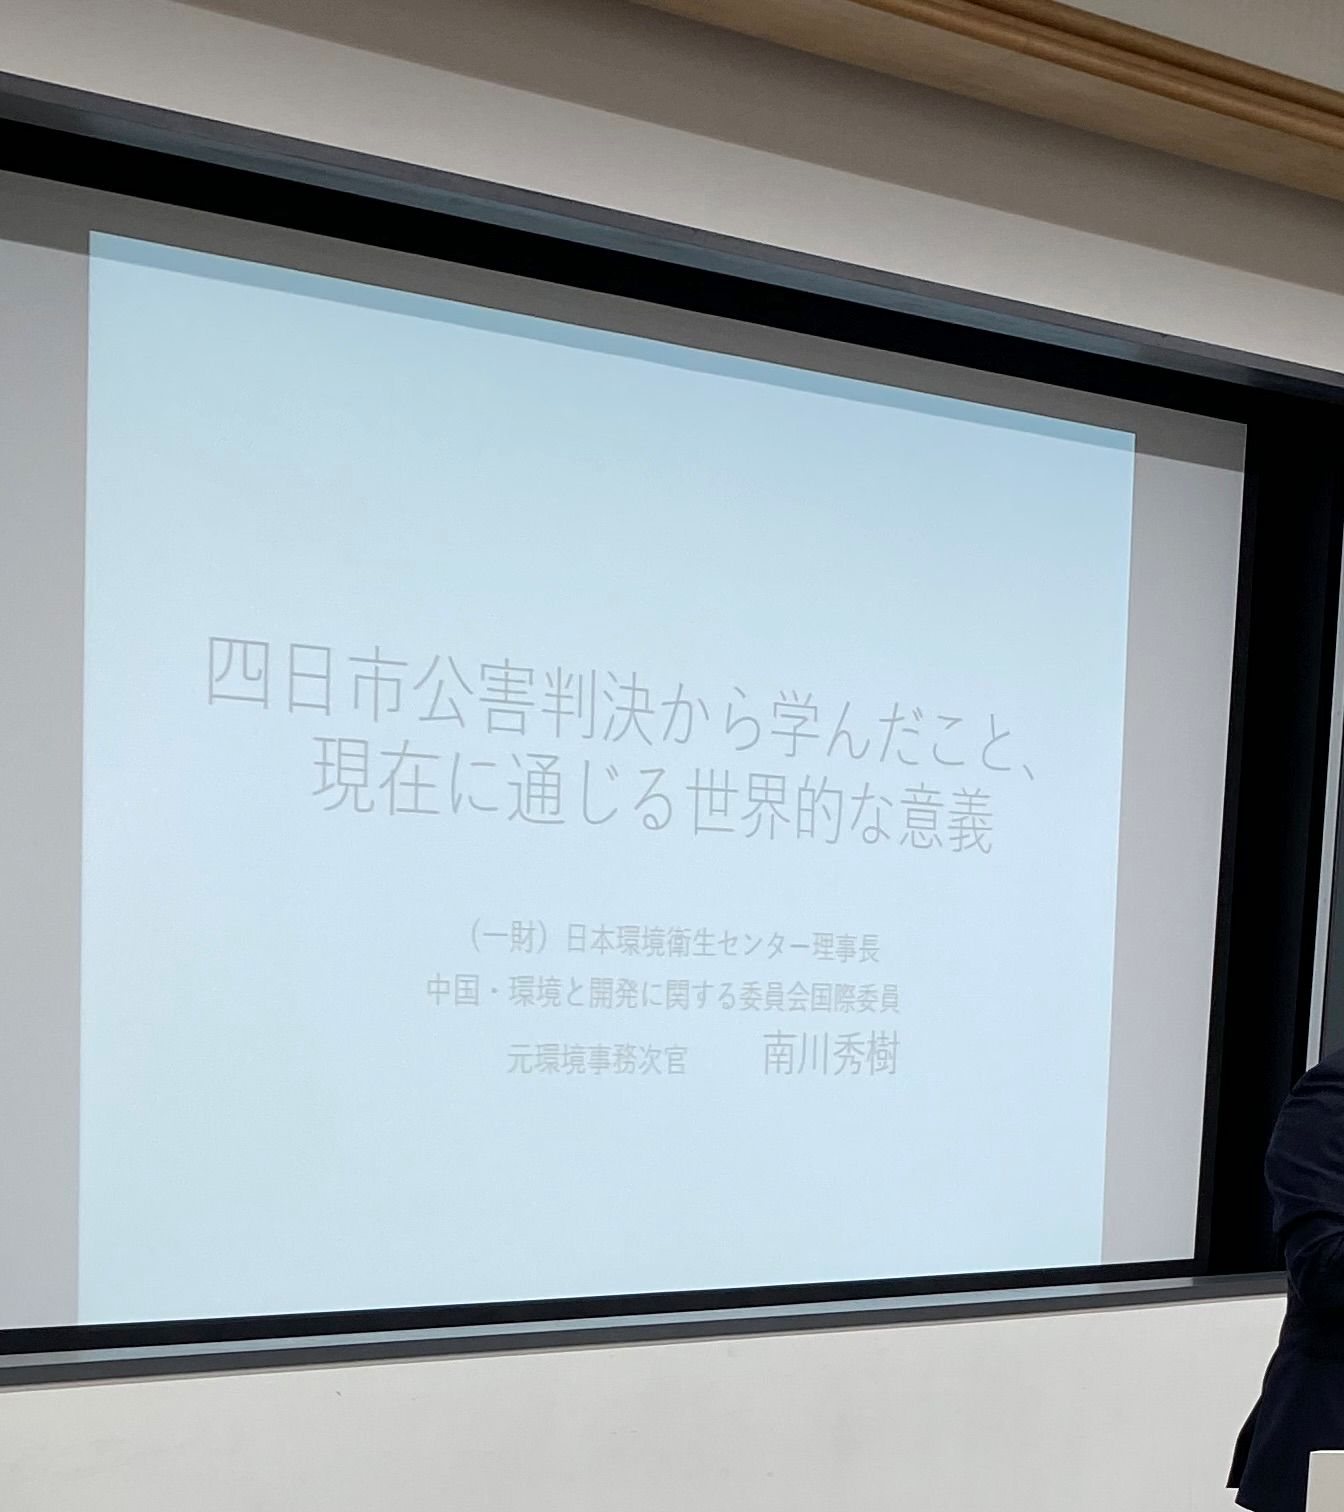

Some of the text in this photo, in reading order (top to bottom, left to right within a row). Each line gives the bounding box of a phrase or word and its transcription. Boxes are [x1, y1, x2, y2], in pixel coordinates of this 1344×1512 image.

[208, 636, 1035, 781] 四日市公害判決から学んだこと、
[312, 736, 994, 855] 現在に通じる世界的な意義
[426, 972, 900, 1014] 中国・環境と開発に関する委員会国際委員
[507, 1028, 901, 1076] 元環境事務次官 南川秀樹
